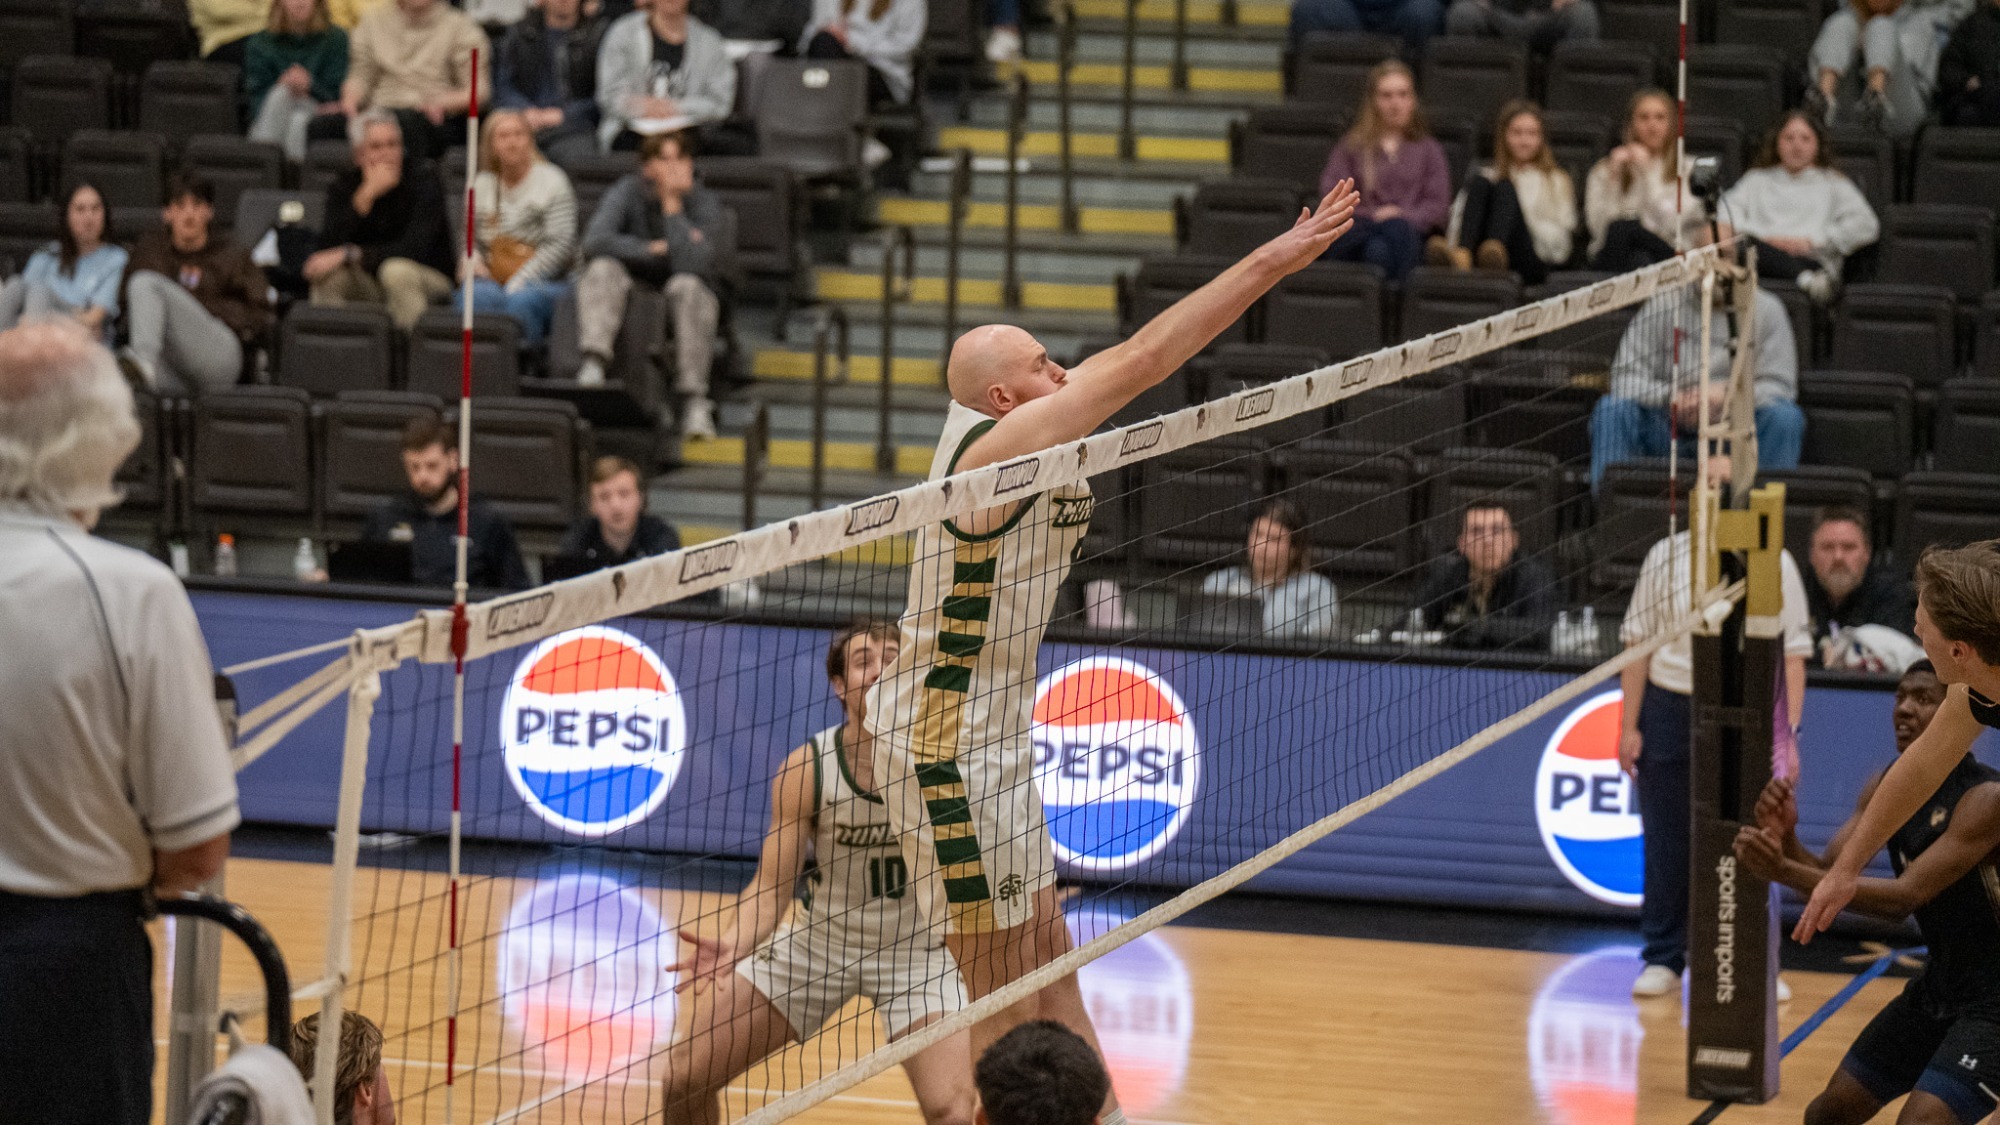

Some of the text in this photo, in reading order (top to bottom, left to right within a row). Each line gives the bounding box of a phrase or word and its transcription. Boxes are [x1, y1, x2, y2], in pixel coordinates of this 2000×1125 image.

[516, 706, 669, 752] PEPSI
[1034, 741, 1183, 786] PEPSI
[870, 855, 907, 899] 10
